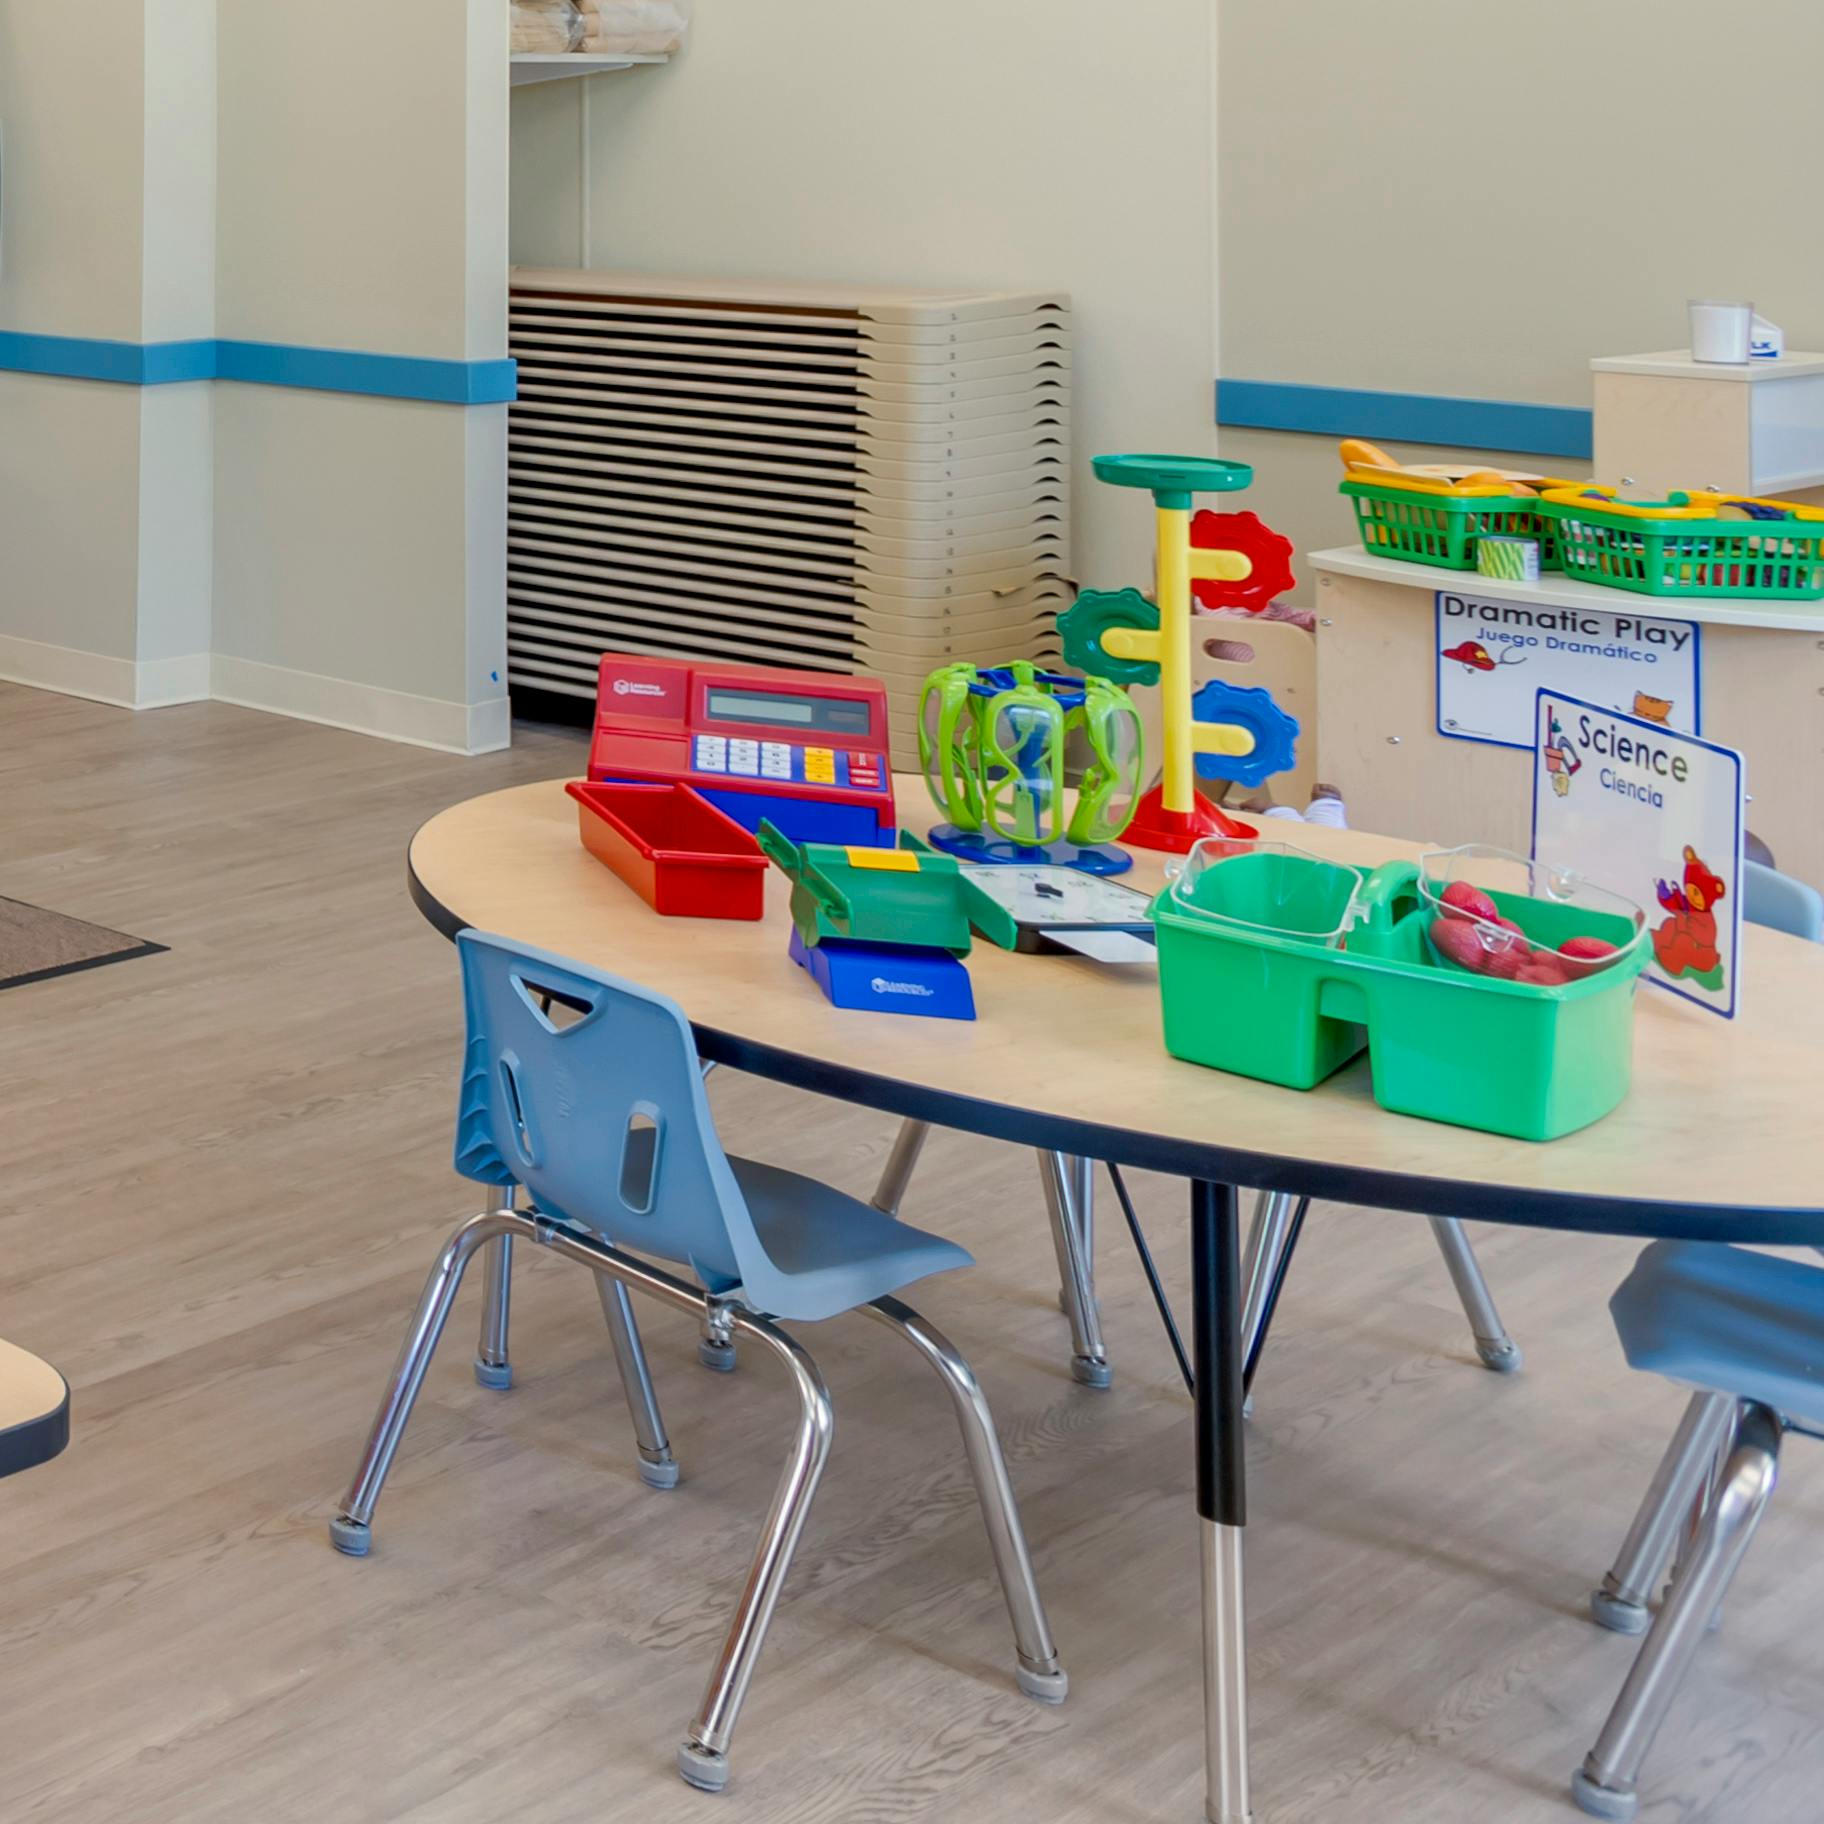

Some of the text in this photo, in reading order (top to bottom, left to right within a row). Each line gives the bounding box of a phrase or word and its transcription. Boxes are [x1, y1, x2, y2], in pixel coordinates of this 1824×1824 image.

[1444, 595, 1691, 652] Dramatic Play
[1475, 626, 1659, 664] Juego Dramático
[1578, 714, 1689, 783] Science
[1599, 767, 1664, 809] Ciencia
